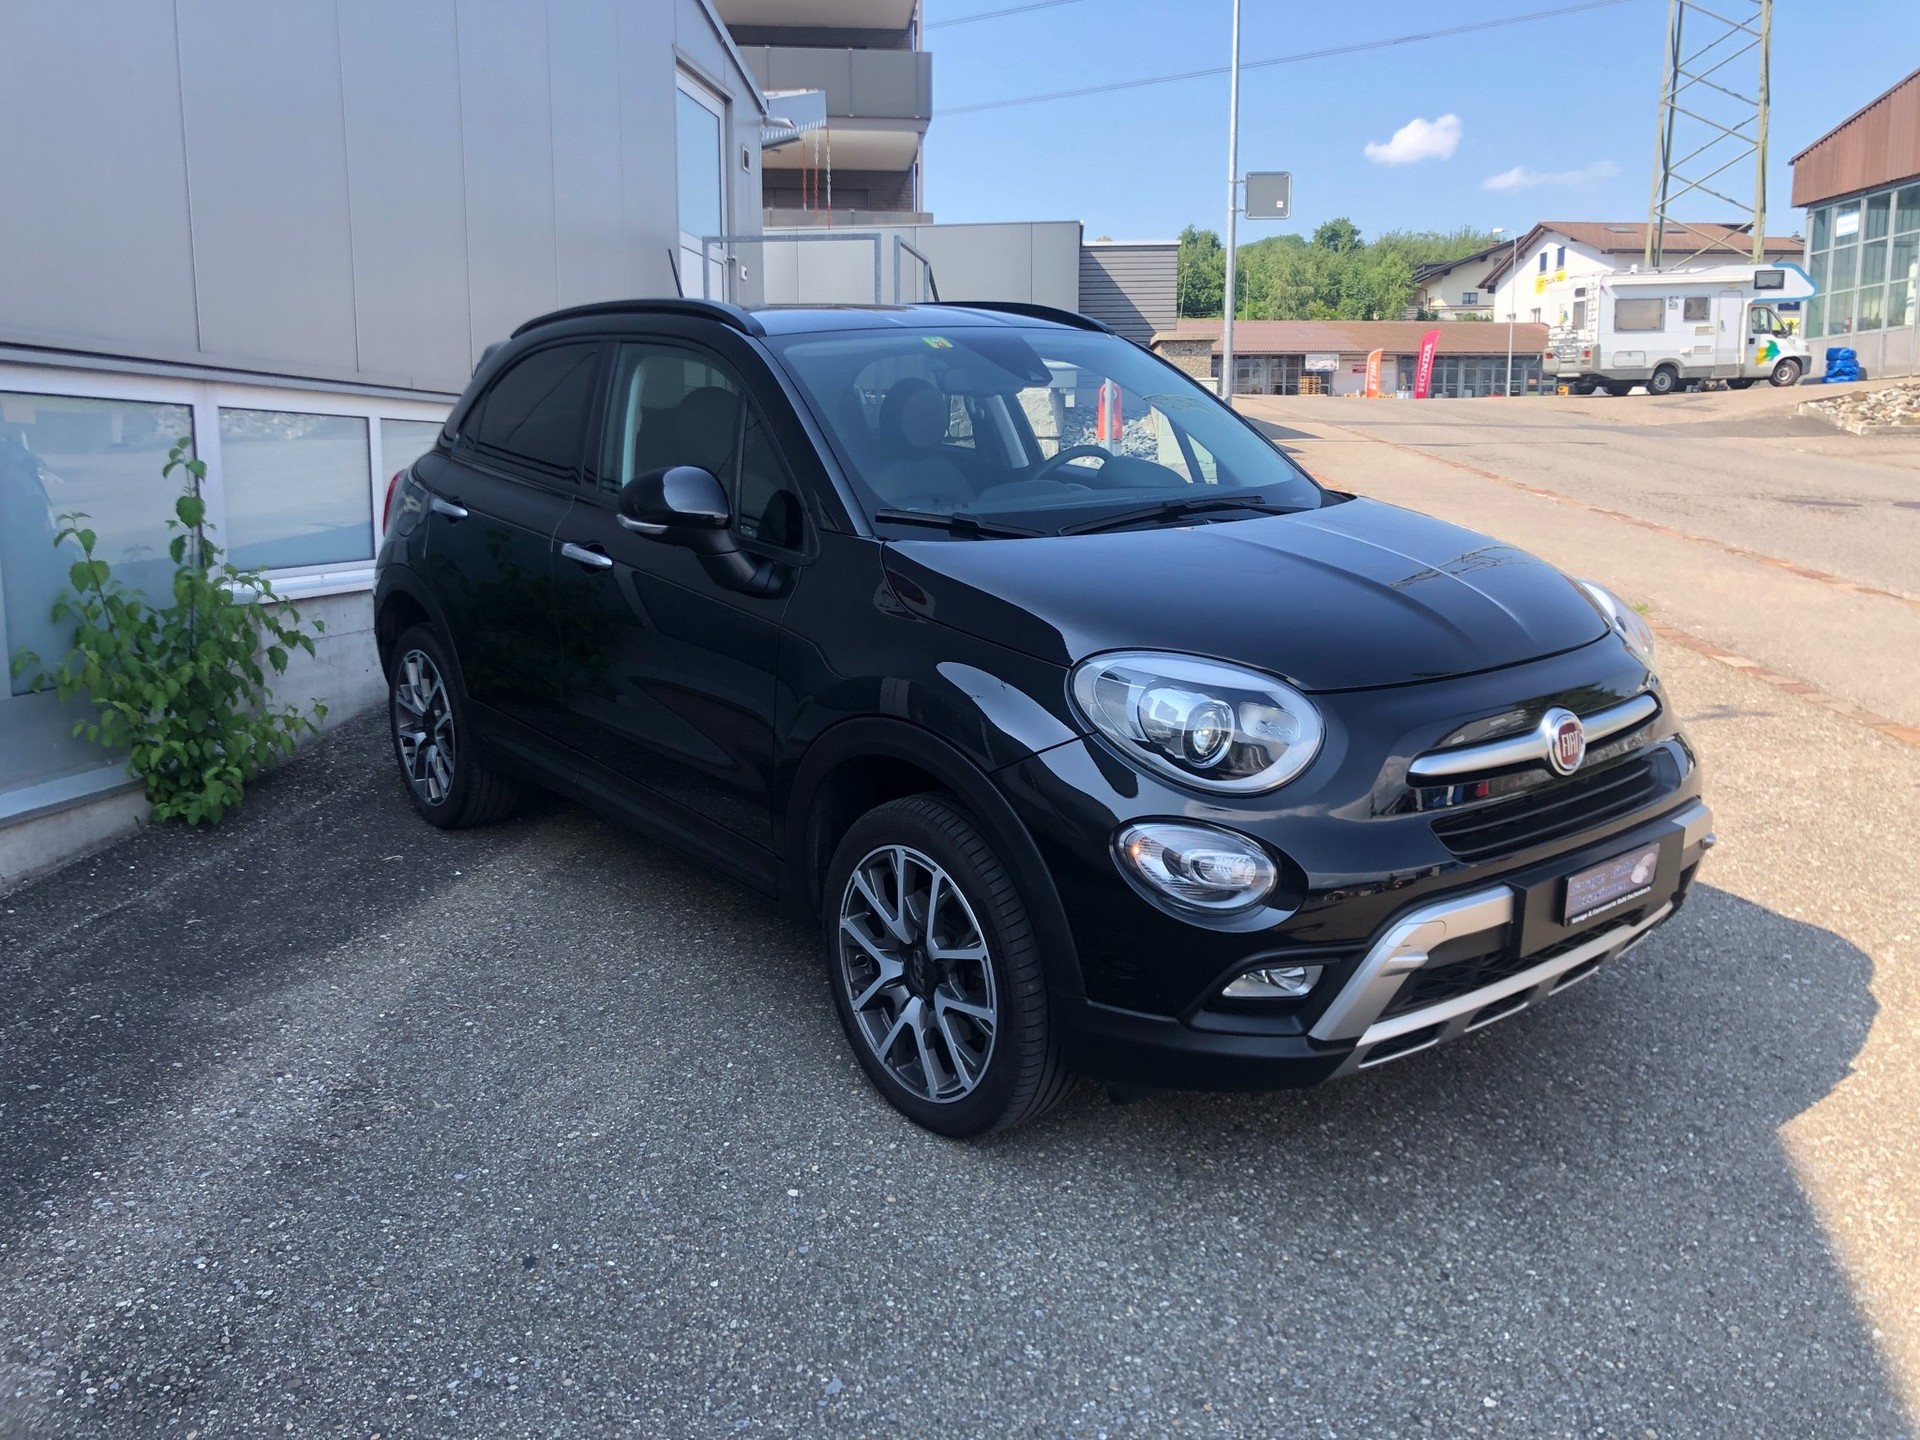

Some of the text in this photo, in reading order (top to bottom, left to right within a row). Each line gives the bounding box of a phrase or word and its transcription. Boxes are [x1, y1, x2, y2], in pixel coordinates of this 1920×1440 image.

[1369, 358, 1378, 390] STIHL
[1418, 343, 1433, 392] HONDA
[1561, 731, 1579, 757] FIAT
